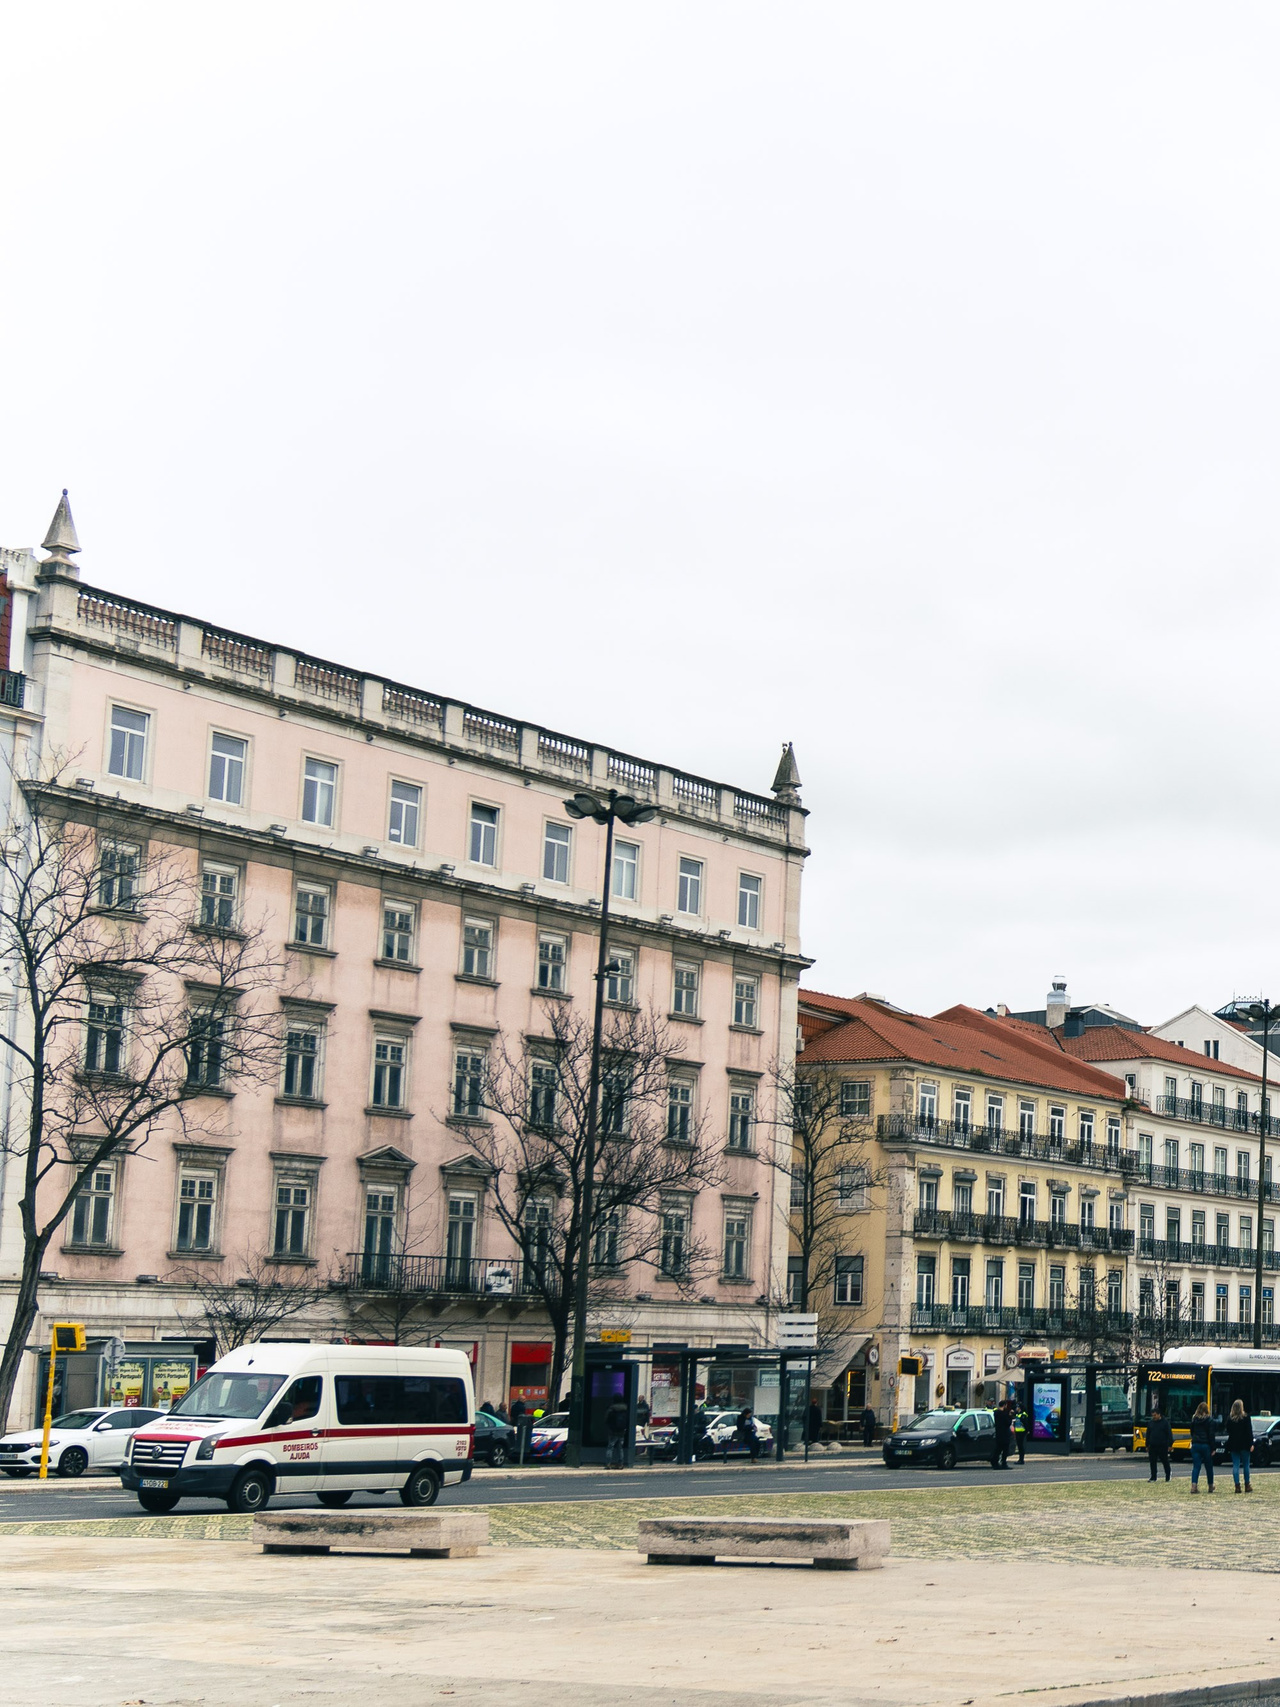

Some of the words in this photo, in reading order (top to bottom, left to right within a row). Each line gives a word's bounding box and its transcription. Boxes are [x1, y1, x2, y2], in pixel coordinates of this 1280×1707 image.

[1147, 1371, 1162, 1381] 722
[282, 1442, 319, 1452] BOMBEIROS
[290, 1452, 310, 1460] AJUDA
